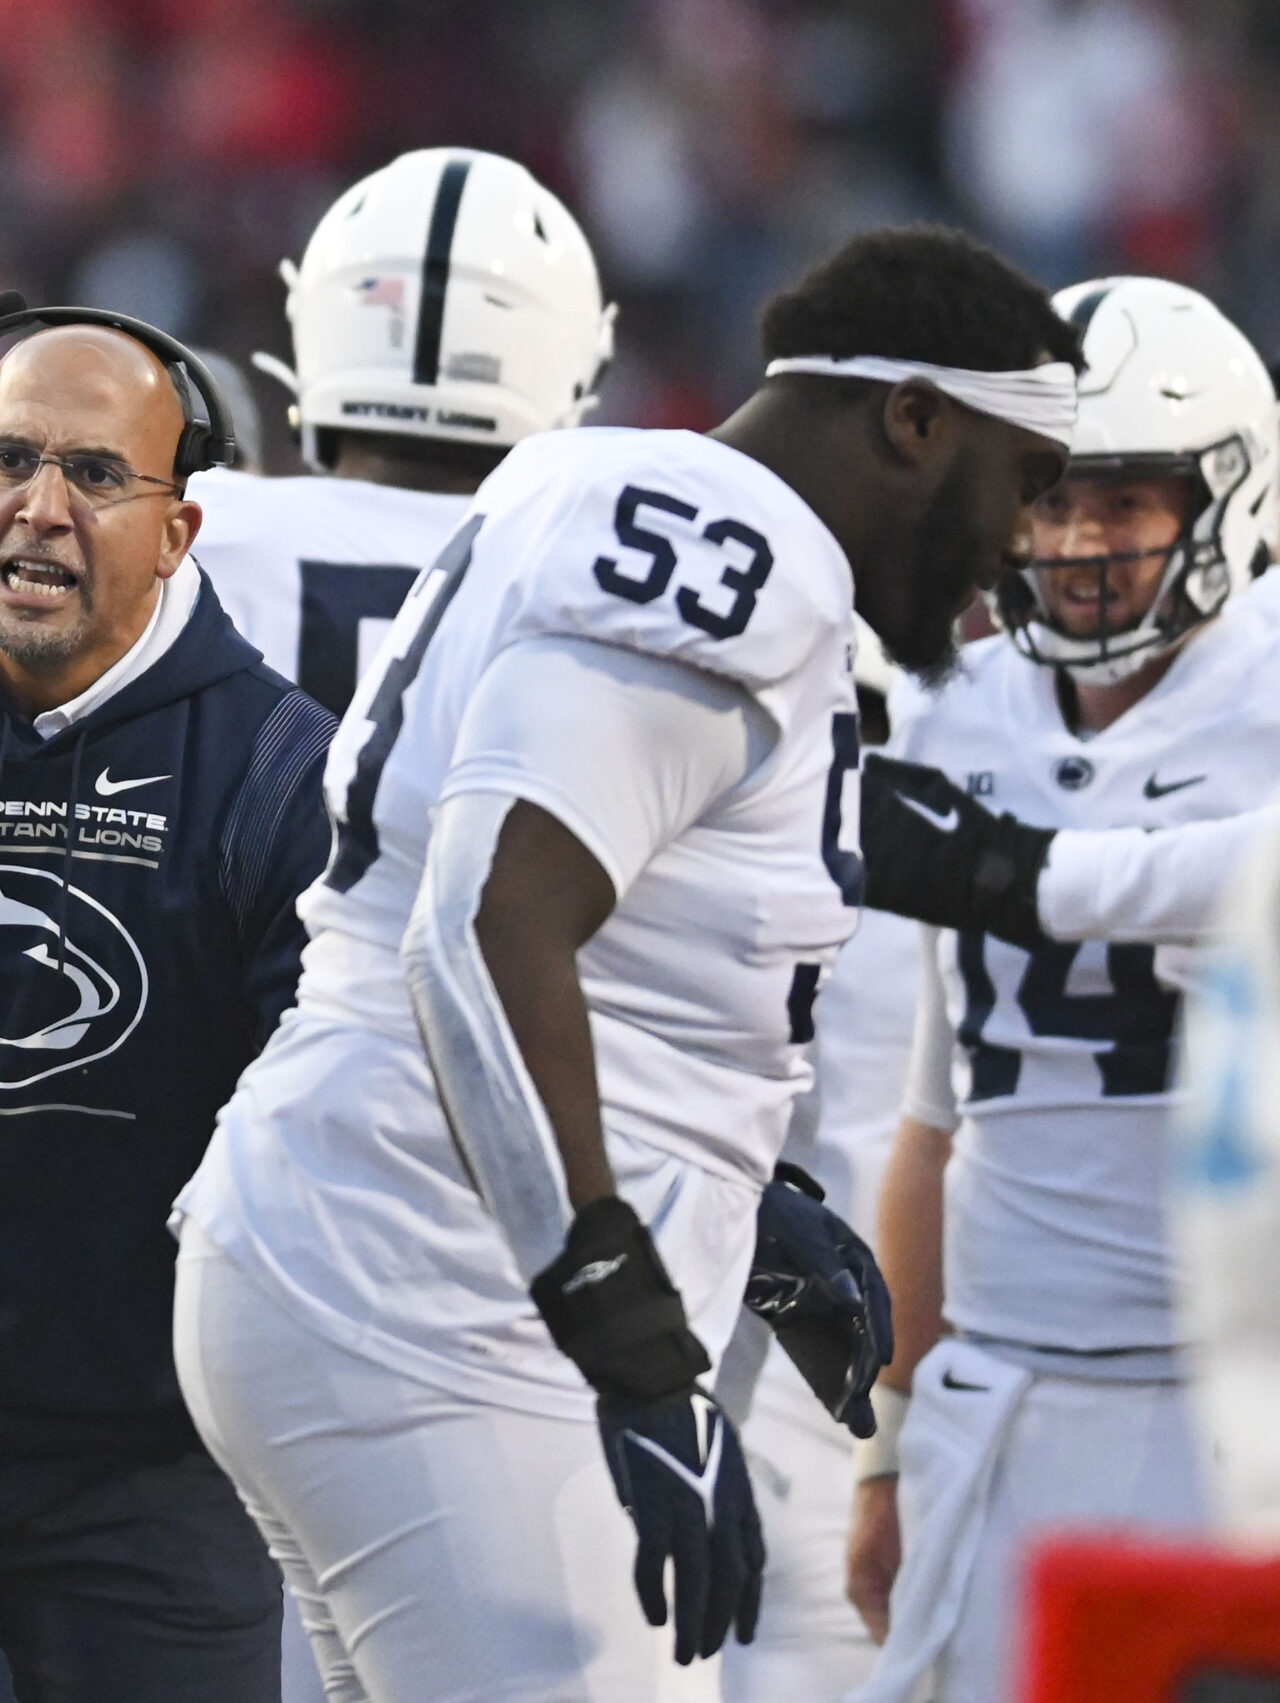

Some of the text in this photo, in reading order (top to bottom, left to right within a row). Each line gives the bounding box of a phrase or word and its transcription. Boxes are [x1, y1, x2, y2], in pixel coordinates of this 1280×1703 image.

[592, 484, 775, 641] 53
[73, 803, 167, 832] STATE
[77, 827, 164, 853] LIONS
